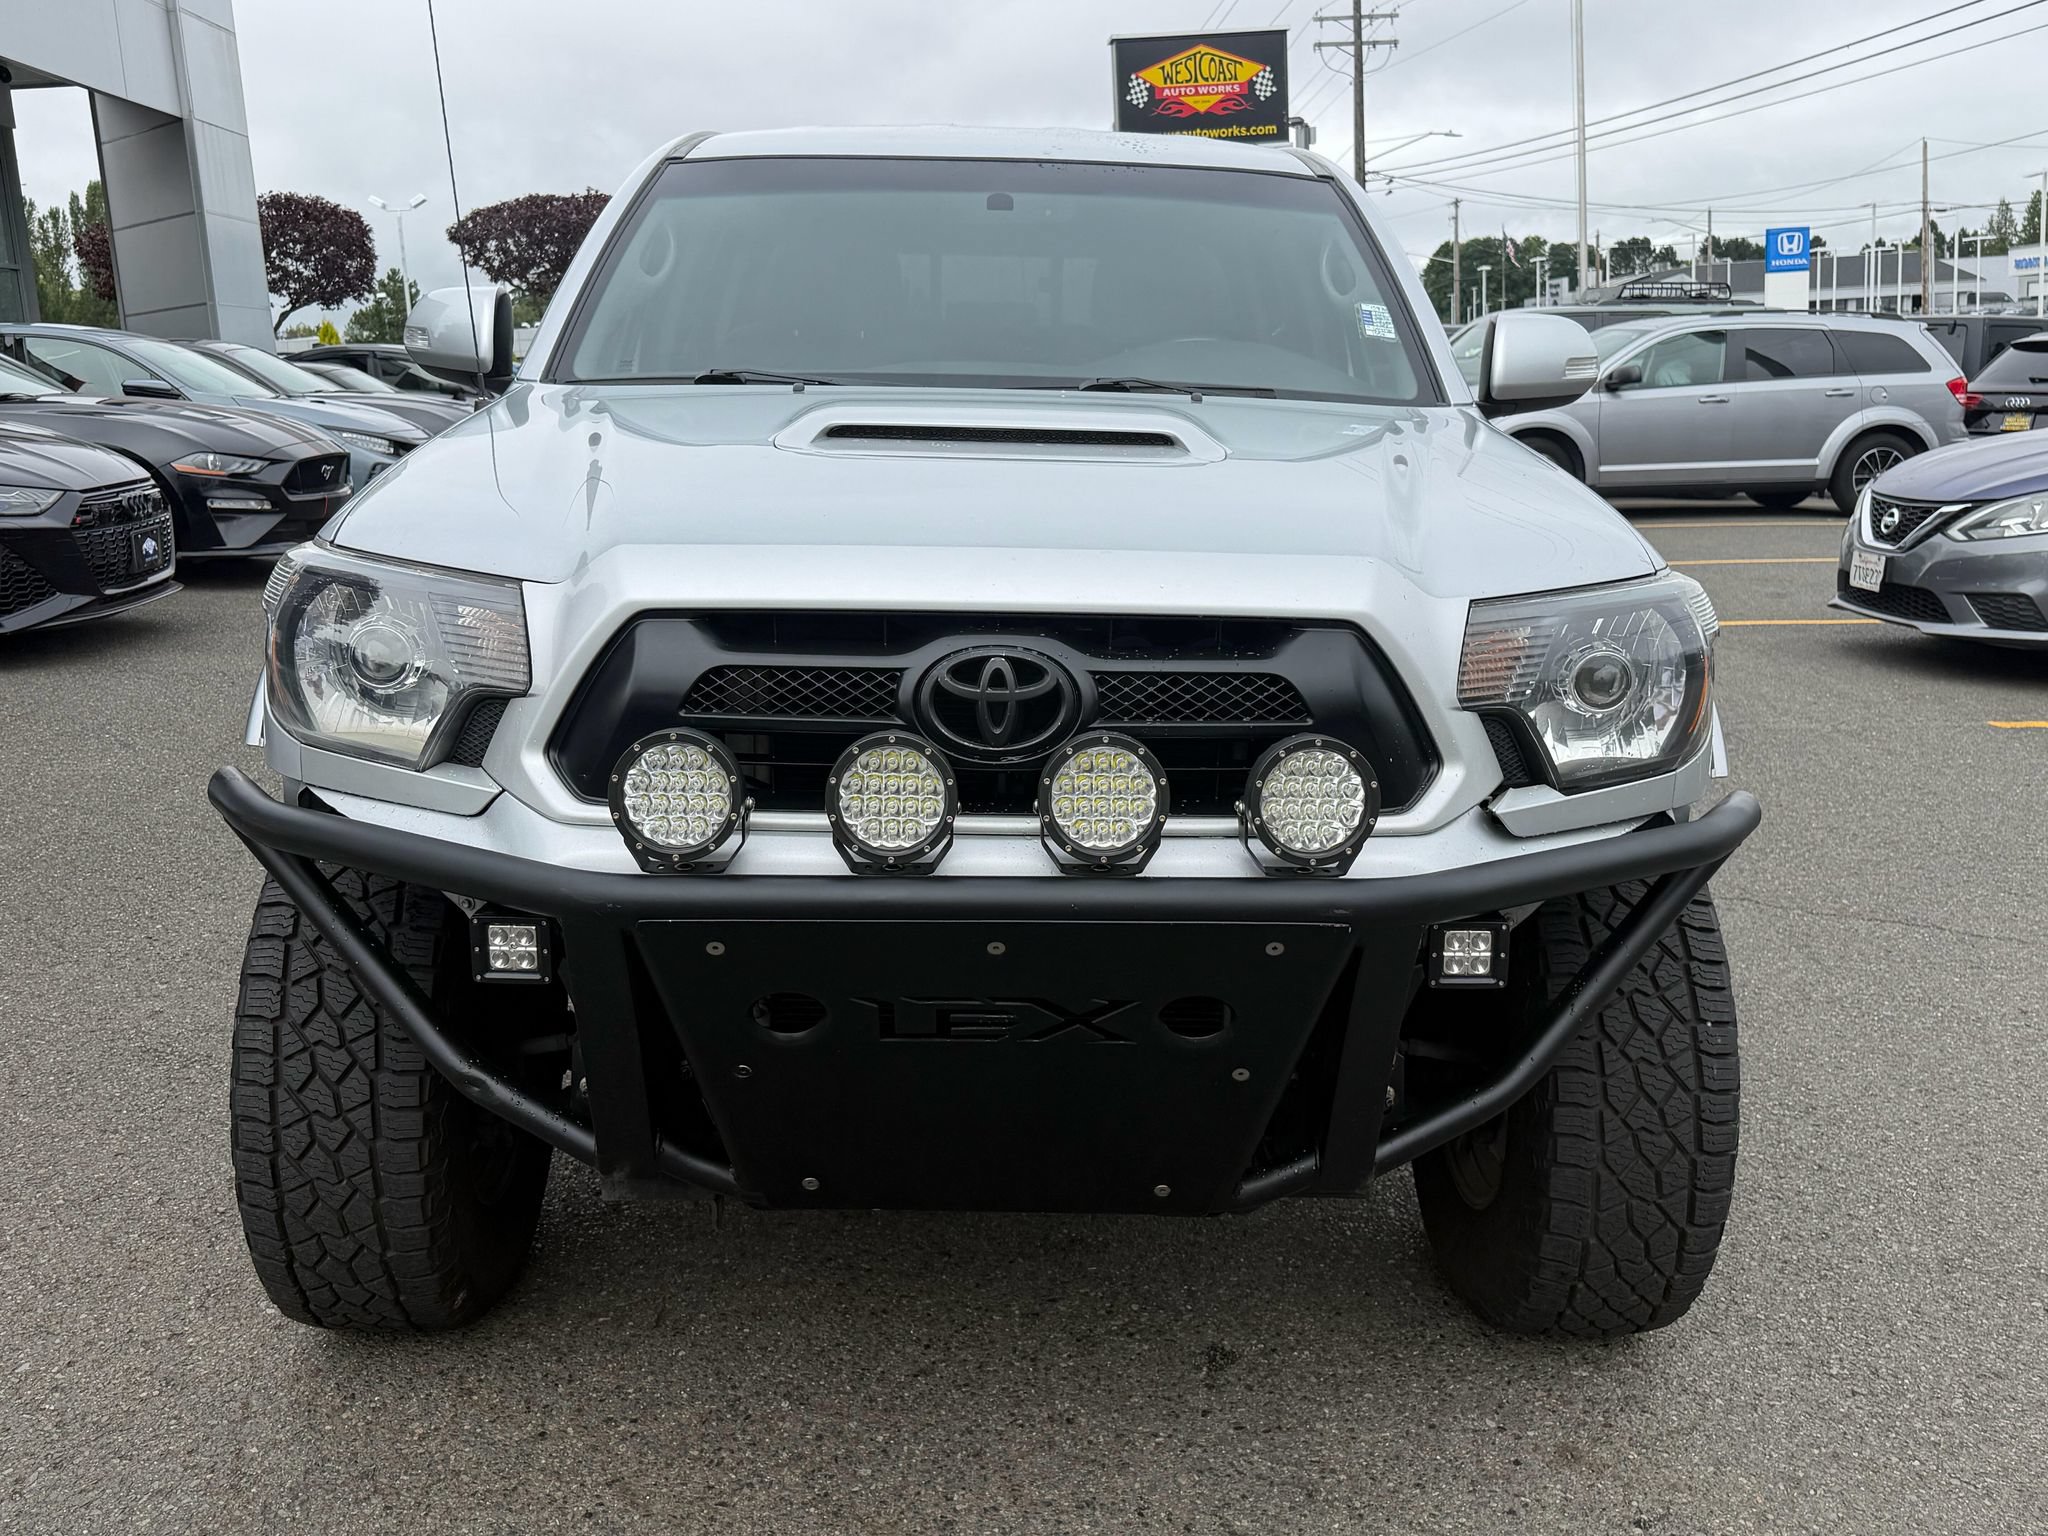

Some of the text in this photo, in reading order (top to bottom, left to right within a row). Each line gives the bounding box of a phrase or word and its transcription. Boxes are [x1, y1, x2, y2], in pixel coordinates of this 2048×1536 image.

[1163, 84, 1240, 96] AUTO WORKS
[1771, 258, 1808, 266] HONDA
[851, 997, 1142, 1045] LEX
